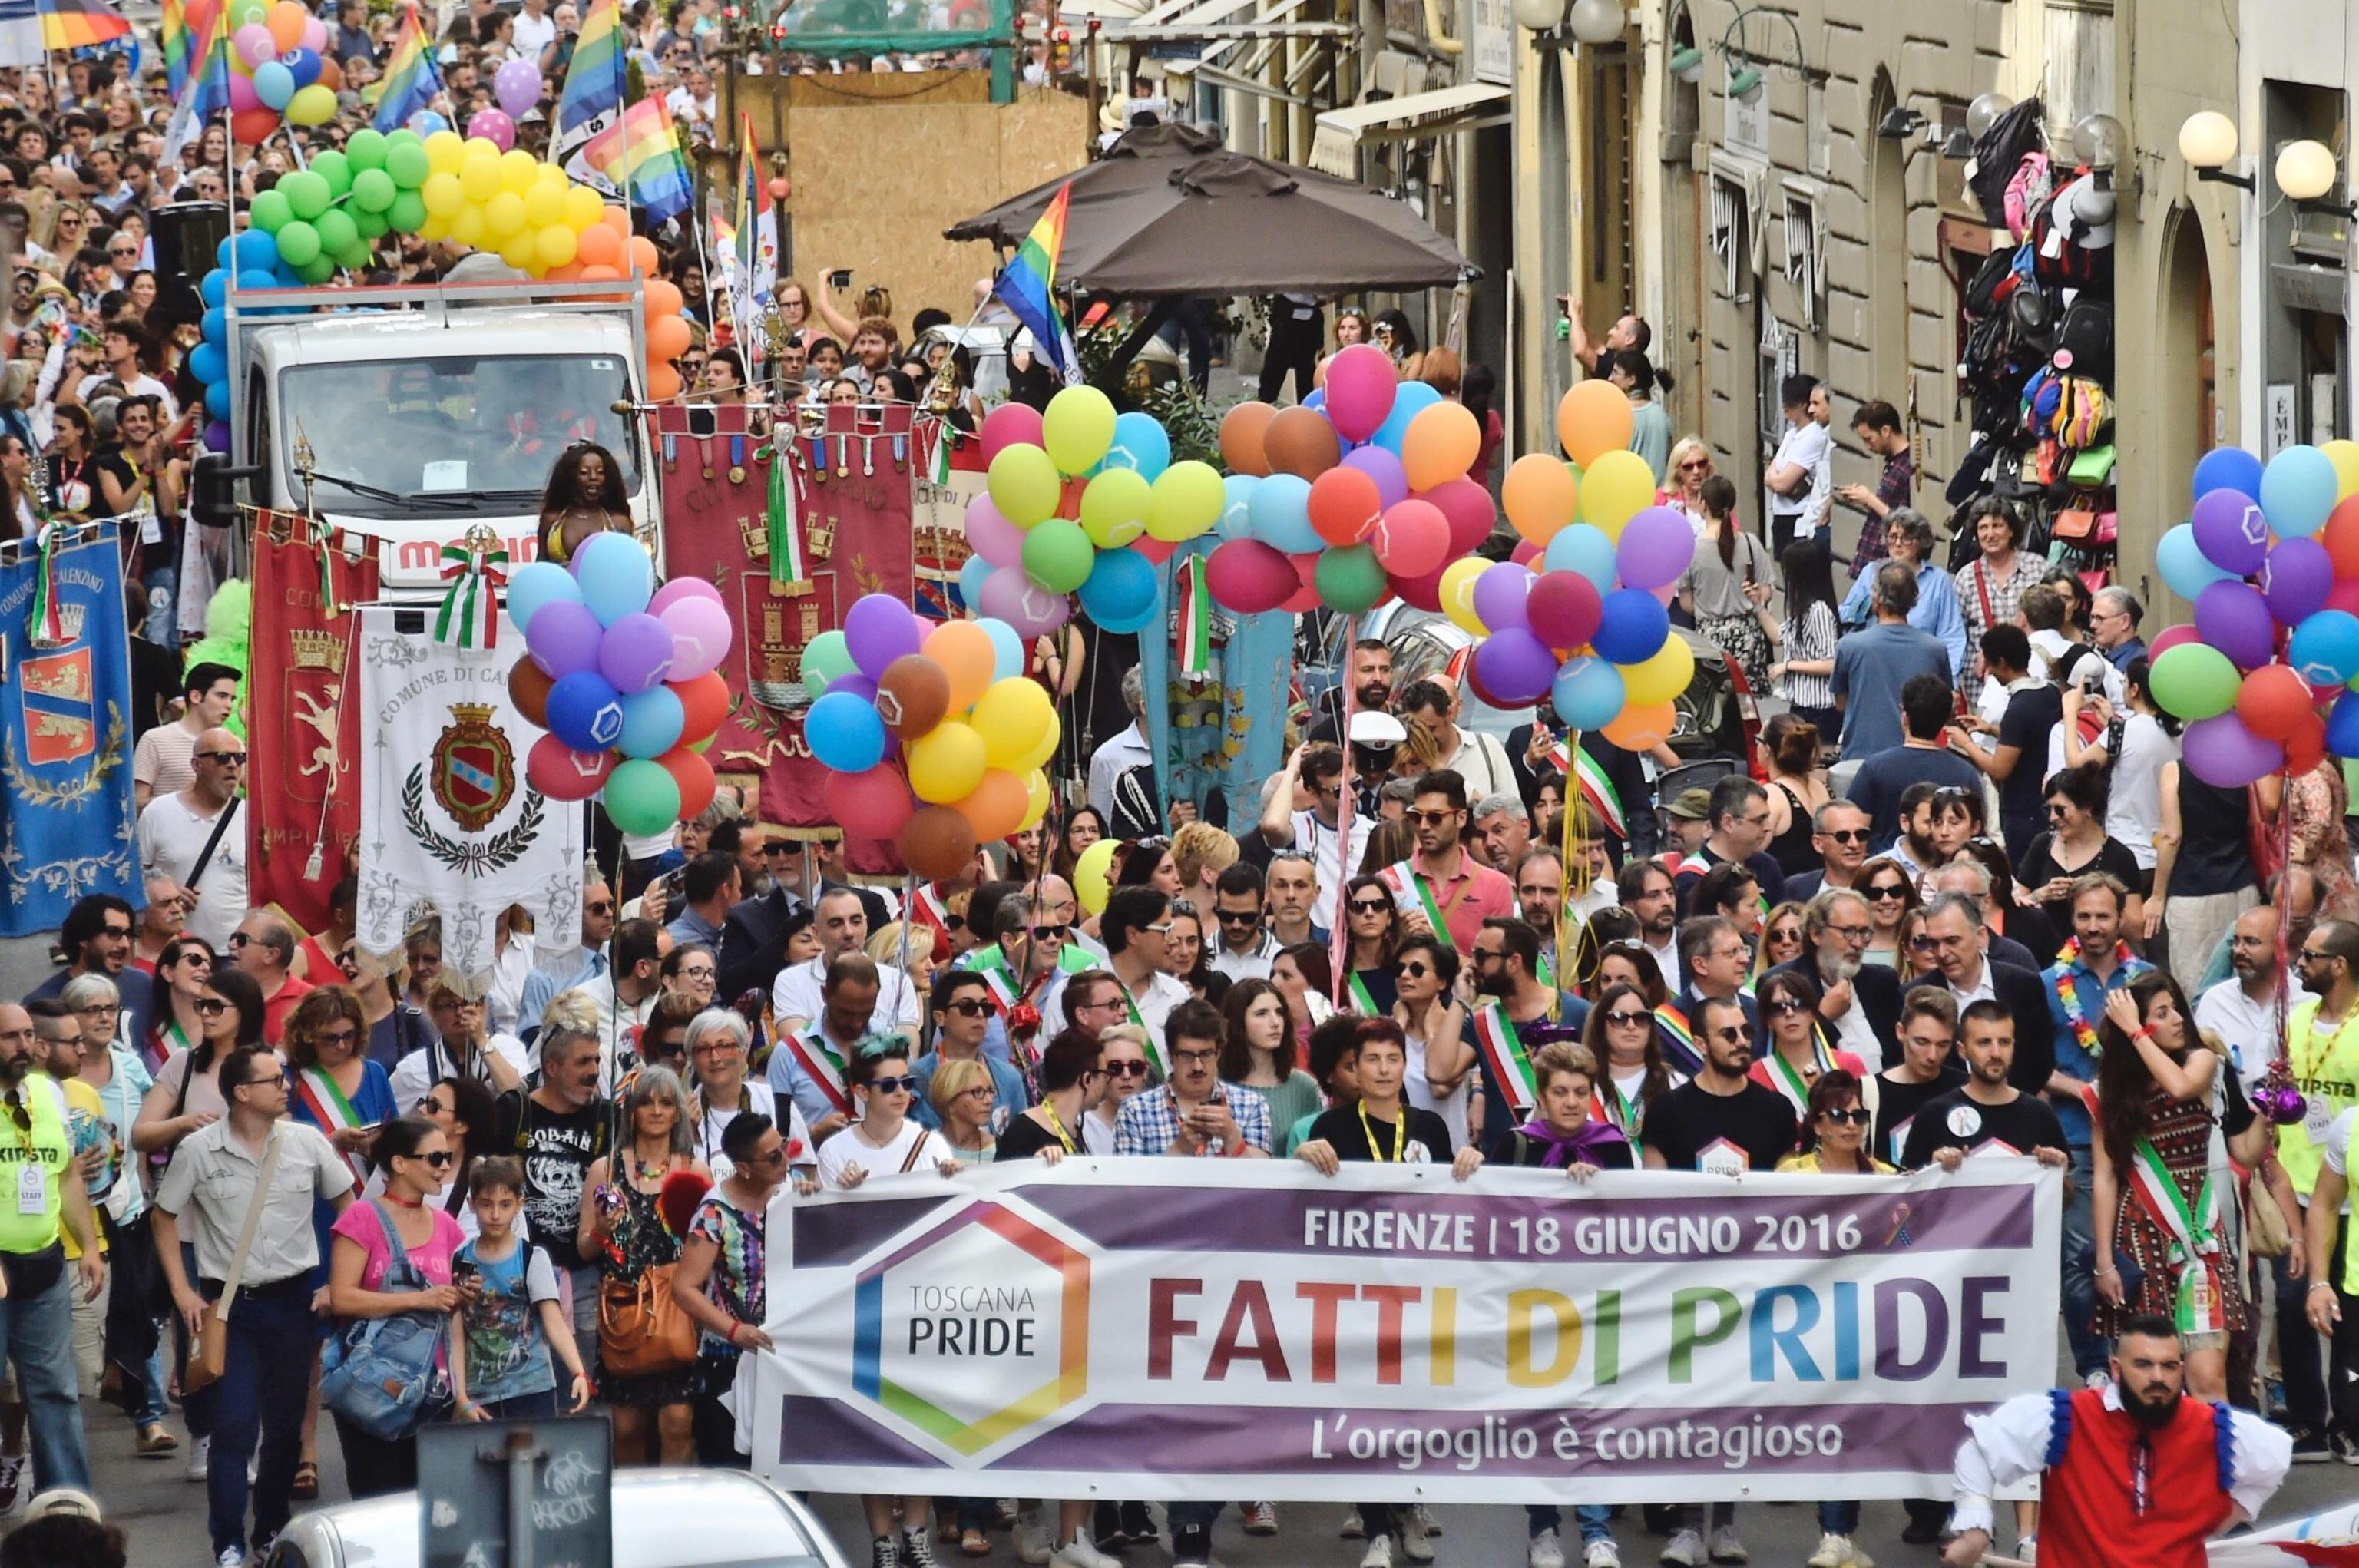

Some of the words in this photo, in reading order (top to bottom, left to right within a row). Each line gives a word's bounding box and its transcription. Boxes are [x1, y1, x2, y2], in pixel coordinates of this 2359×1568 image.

[380, 669, 448, 724] COMUNE
[454, 667, 473, 682] DI
[1304, 1209, 1475, 1253] FIRENZE
[1510, 1216, 1560, 1255] 18
[1575, 1214, 1741, 1256] GIUGNO
[1754, 1212, 1862, 1252] 2016
[909, 1285, 1035, 1312] TOSCANA
[908, 1318, 1035, 1357] PRIDE
[1147, 1278, 1457, 1387] FATTI
[1507, 1288, 1620, 1388] DI
[1668, 1275, 2010, 1384] PRIDE
[1312, 1414, 1537, 1472] L'orgoglio
[1553, 1420, 1580, 1460] è
[1596, 1414, 1843, 1469] contagioso
